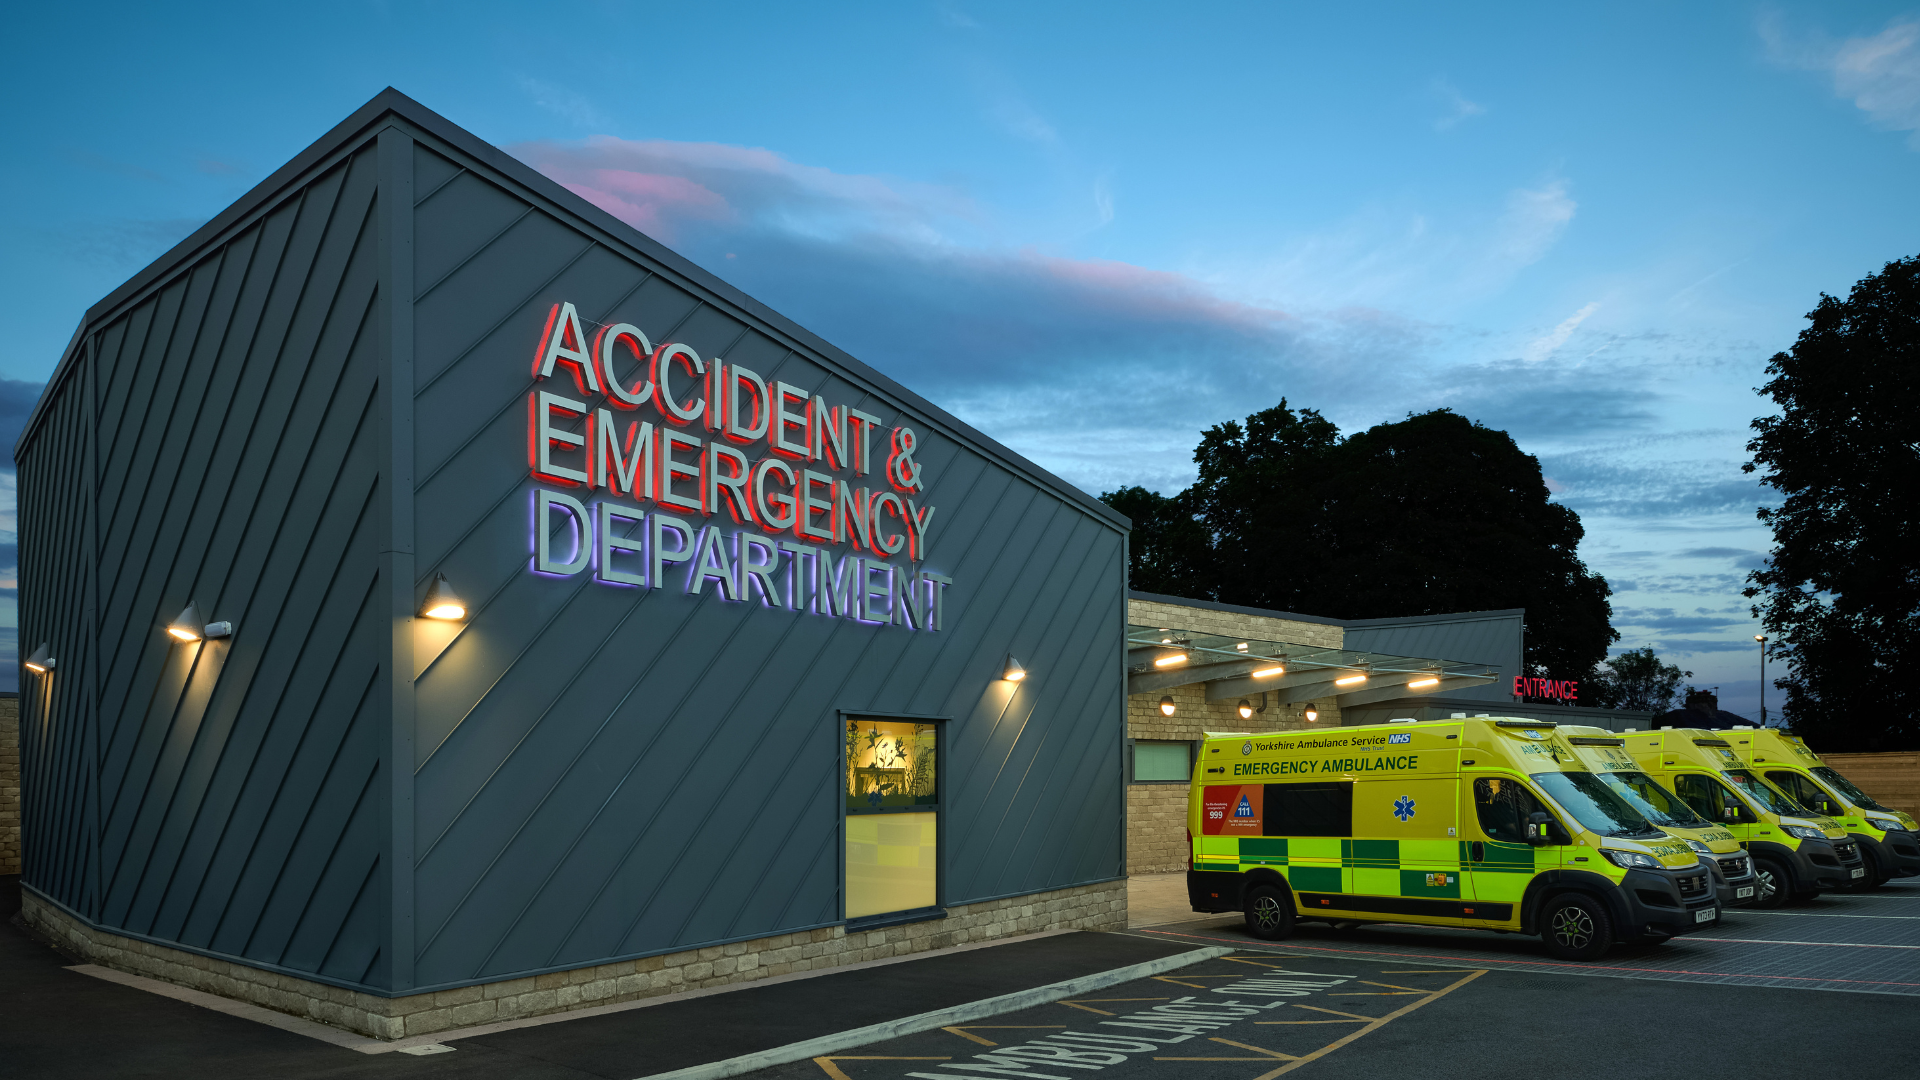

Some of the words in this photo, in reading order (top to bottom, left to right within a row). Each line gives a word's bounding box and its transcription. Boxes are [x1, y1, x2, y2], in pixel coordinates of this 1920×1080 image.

[537, 301, 881, 475] ACCIDENT
[894, 427, 924, 493] &
[534, 390, 935, 561] EMERGENCY
[534, 489, 953, 631] DEPARTMENT
[1513, 676, 1578, 700] ENTRANCE
[1255, 741, 1295, 751] Yorkshire
[1297, 738, 1348, 749] Ambulance
[1351, 735, 1386, 746] Service
[1388, 733, 1411, 744] NHS
[1233, 760, 1318, 776] EMERGENCY
[1321, 755, 1419, 773] AMBULANCE
[1209, 811, 1223, 819] 999
[1238, 807, 1250, 815] 111
[1210, 969, 1358, 997] ONLY
